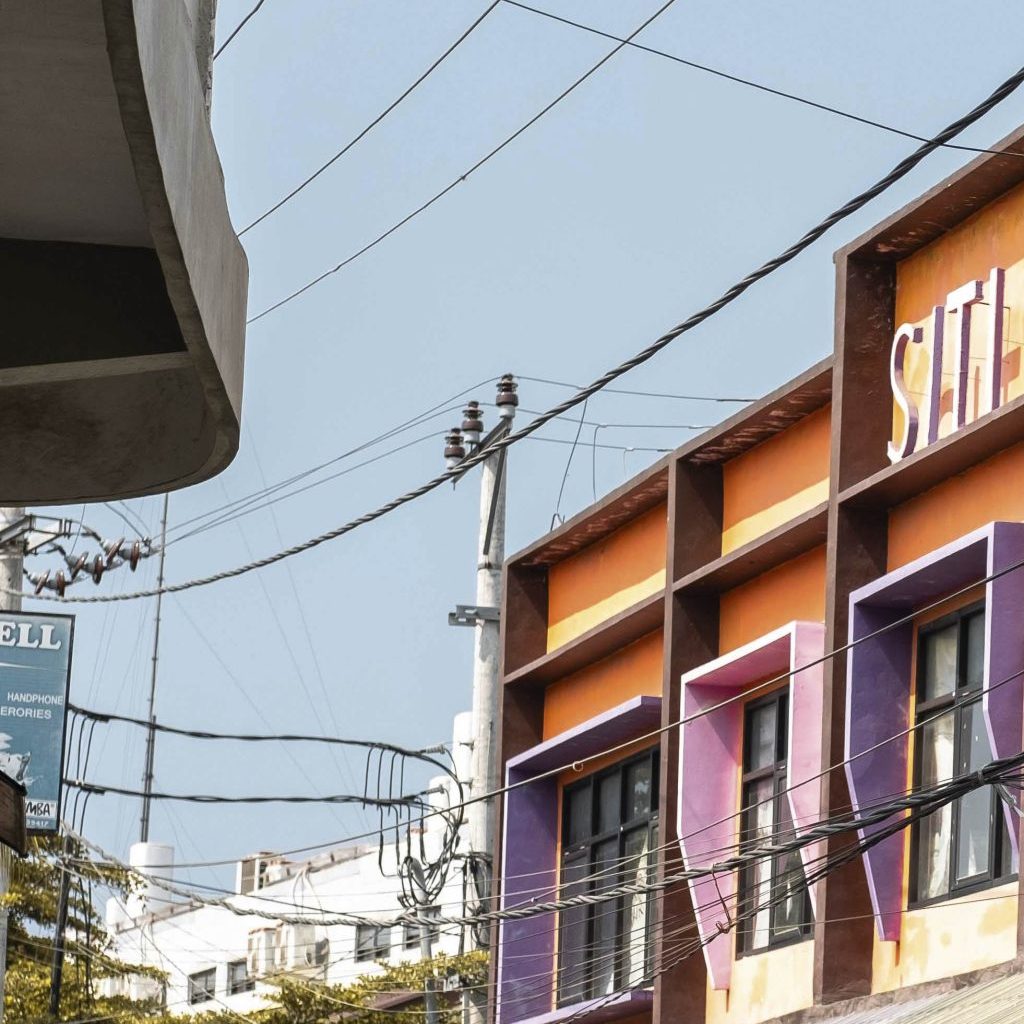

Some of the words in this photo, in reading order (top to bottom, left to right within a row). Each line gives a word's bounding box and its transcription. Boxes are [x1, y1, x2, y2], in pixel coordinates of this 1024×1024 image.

[887, 266, 1006, 466] SITI
[7, 691, 64, 706] HANDPHONE
[0, 706, 52, 719] ERORIES
